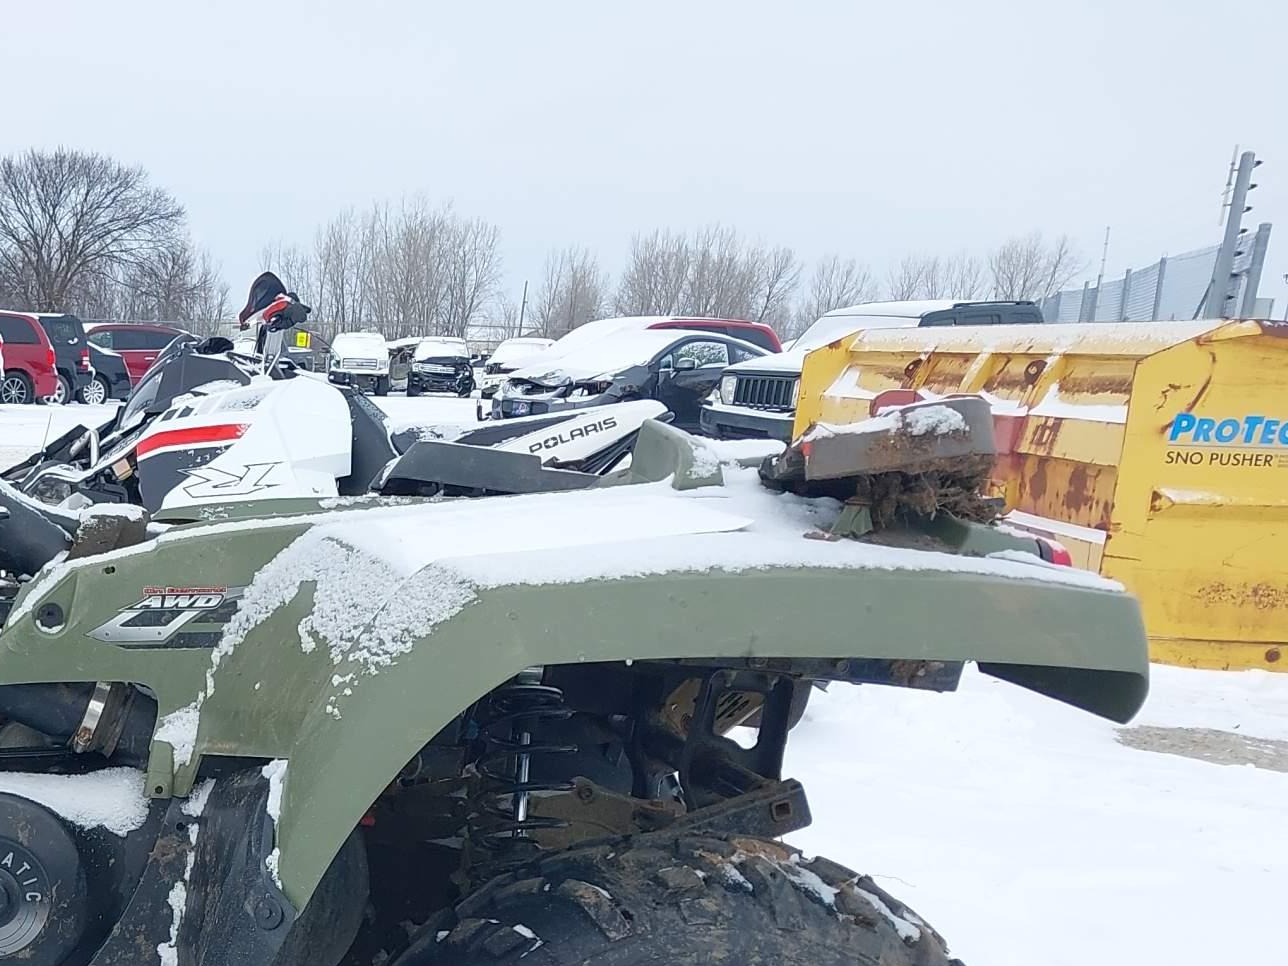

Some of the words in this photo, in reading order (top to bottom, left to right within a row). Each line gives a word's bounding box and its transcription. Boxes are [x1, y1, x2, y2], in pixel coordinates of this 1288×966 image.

[528, 417, 617, 453] POLARIS
[1165, 451, 1203, 465] SNO
[1208, 453, 1274, 467] PUSHER
[131, 595, 222, 609] AWD
